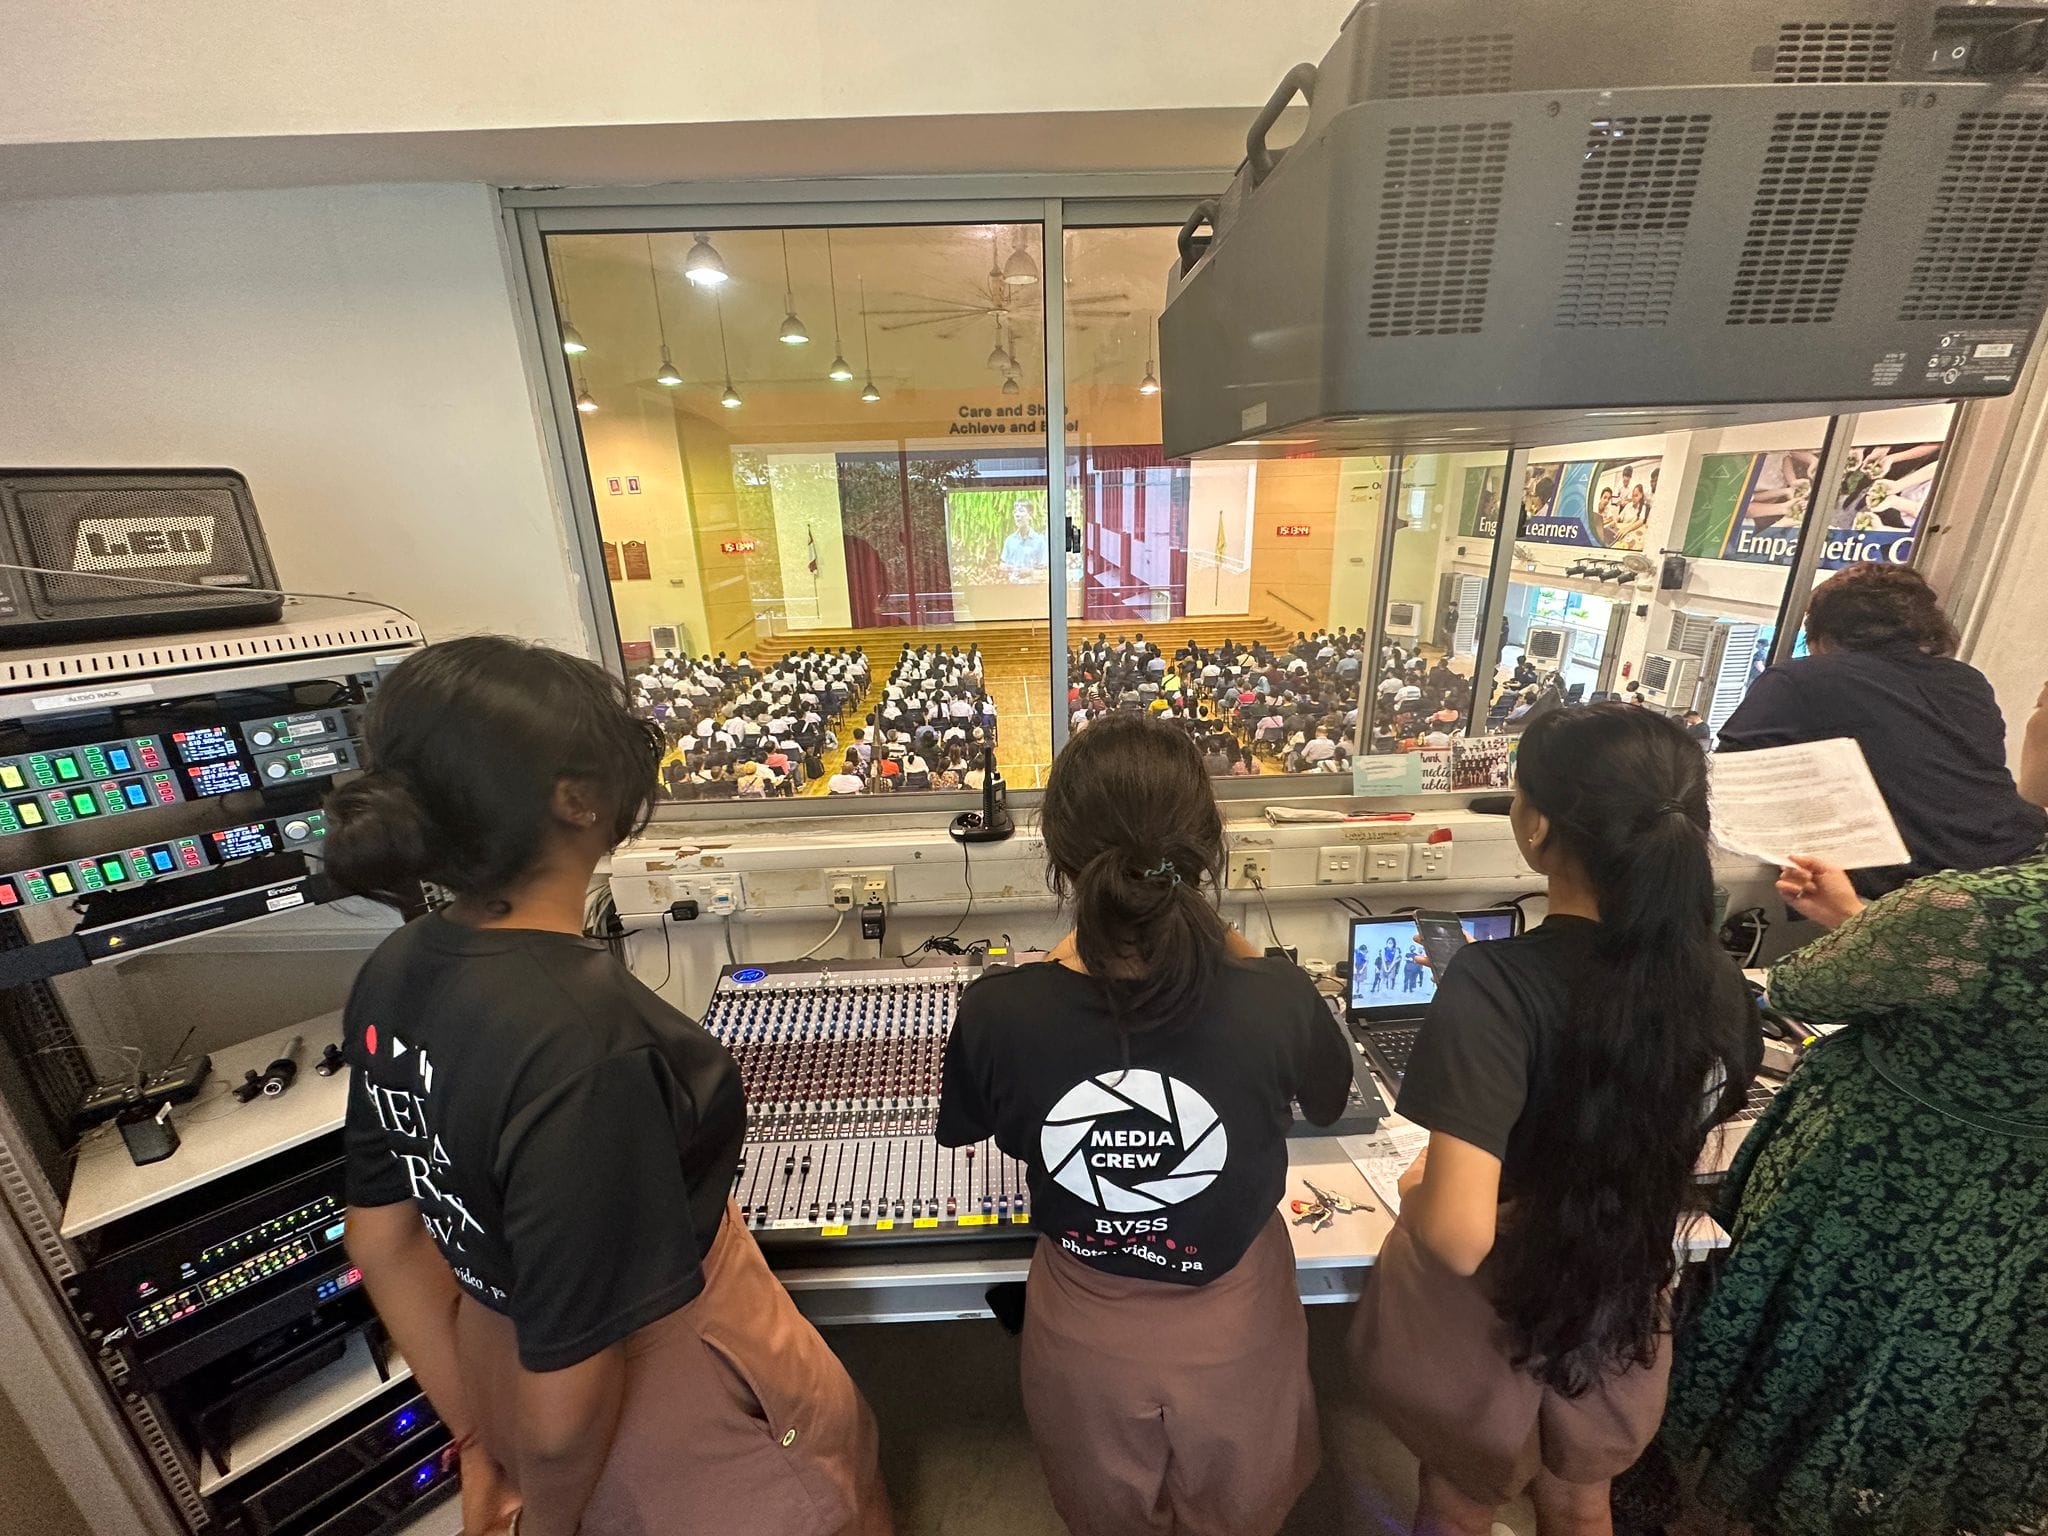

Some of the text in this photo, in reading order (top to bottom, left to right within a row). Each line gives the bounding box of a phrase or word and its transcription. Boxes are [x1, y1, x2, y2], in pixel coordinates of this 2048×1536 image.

[958, 405, 992, 418] Care
[996, 404, 1023, 416] and
[949, 421, 1006, 434] Achieve
[1010, 420, 1036, 433] and
[1525, 522, 1579, 539] Learners
[1737, 529, 1881, 561] Empaetic
[1090, 1130, 1175, 1147] MEDIA
[1091, 1152, 1161, 1169] CREW
[1095, 1217, 1168, 1236] BVSS
[1121, 1244, 1167, 1266] video
[1181, 1260, 1203, 1272] pa
